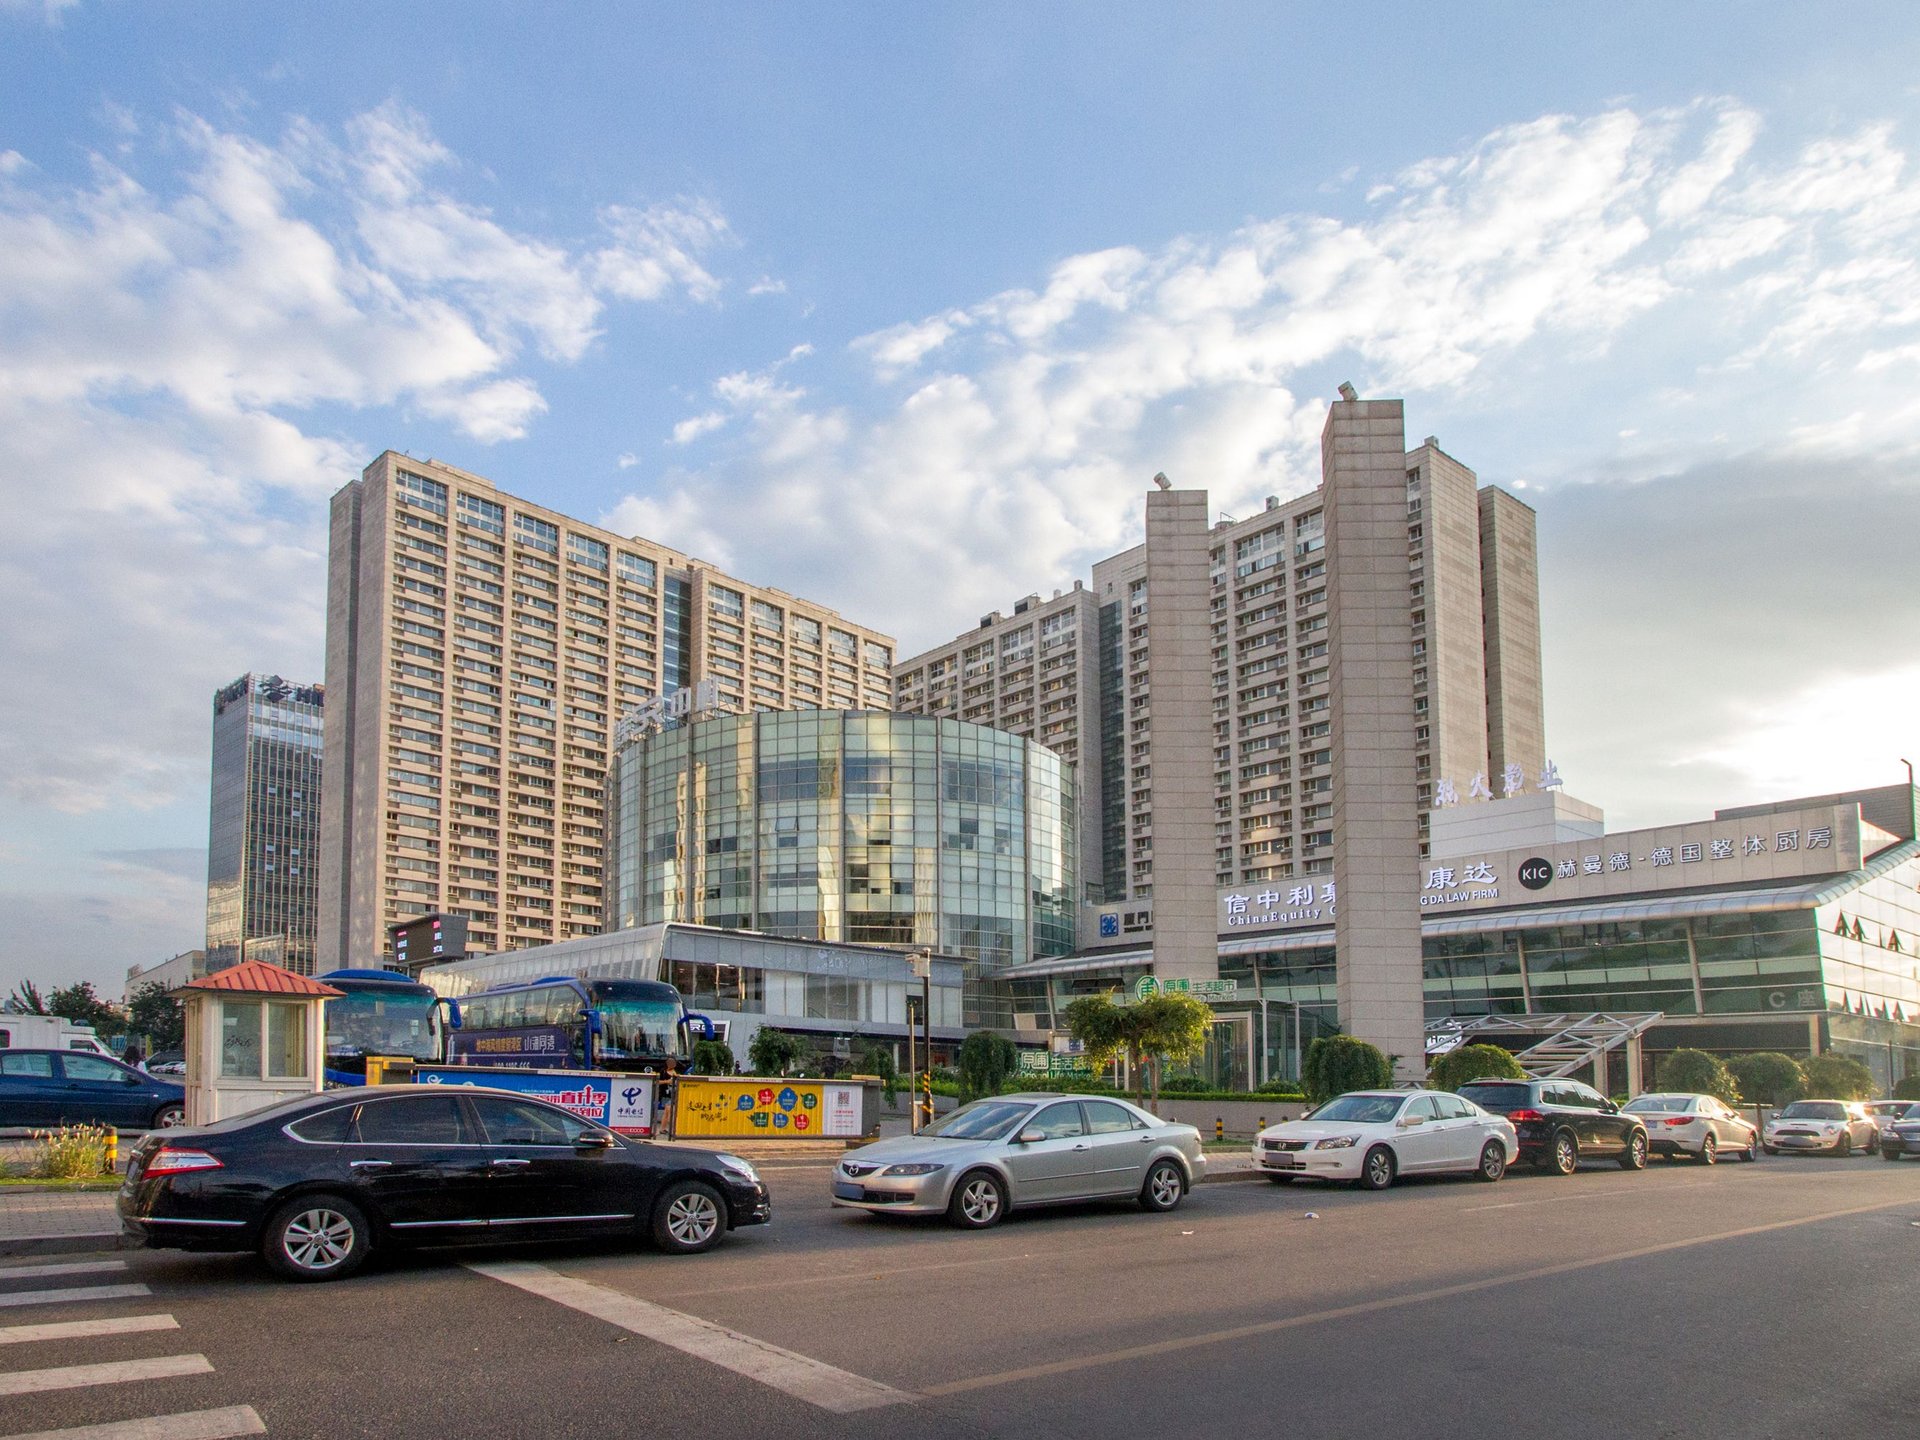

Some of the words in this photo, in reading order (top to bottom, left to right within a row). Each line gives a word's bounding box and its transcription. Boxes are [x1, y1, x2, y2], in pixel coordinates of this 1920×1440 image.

[1425, 861, 1498, 890] 康达
[1522, 867, 1548, 881] KIC
[1430, 894, 1445, 904] DA
[1447, 891, 1470, 903] LAW
[1472, 888, 1499, 899] FIRM
[1228, 909, 1321, 926] ChinaEquity
